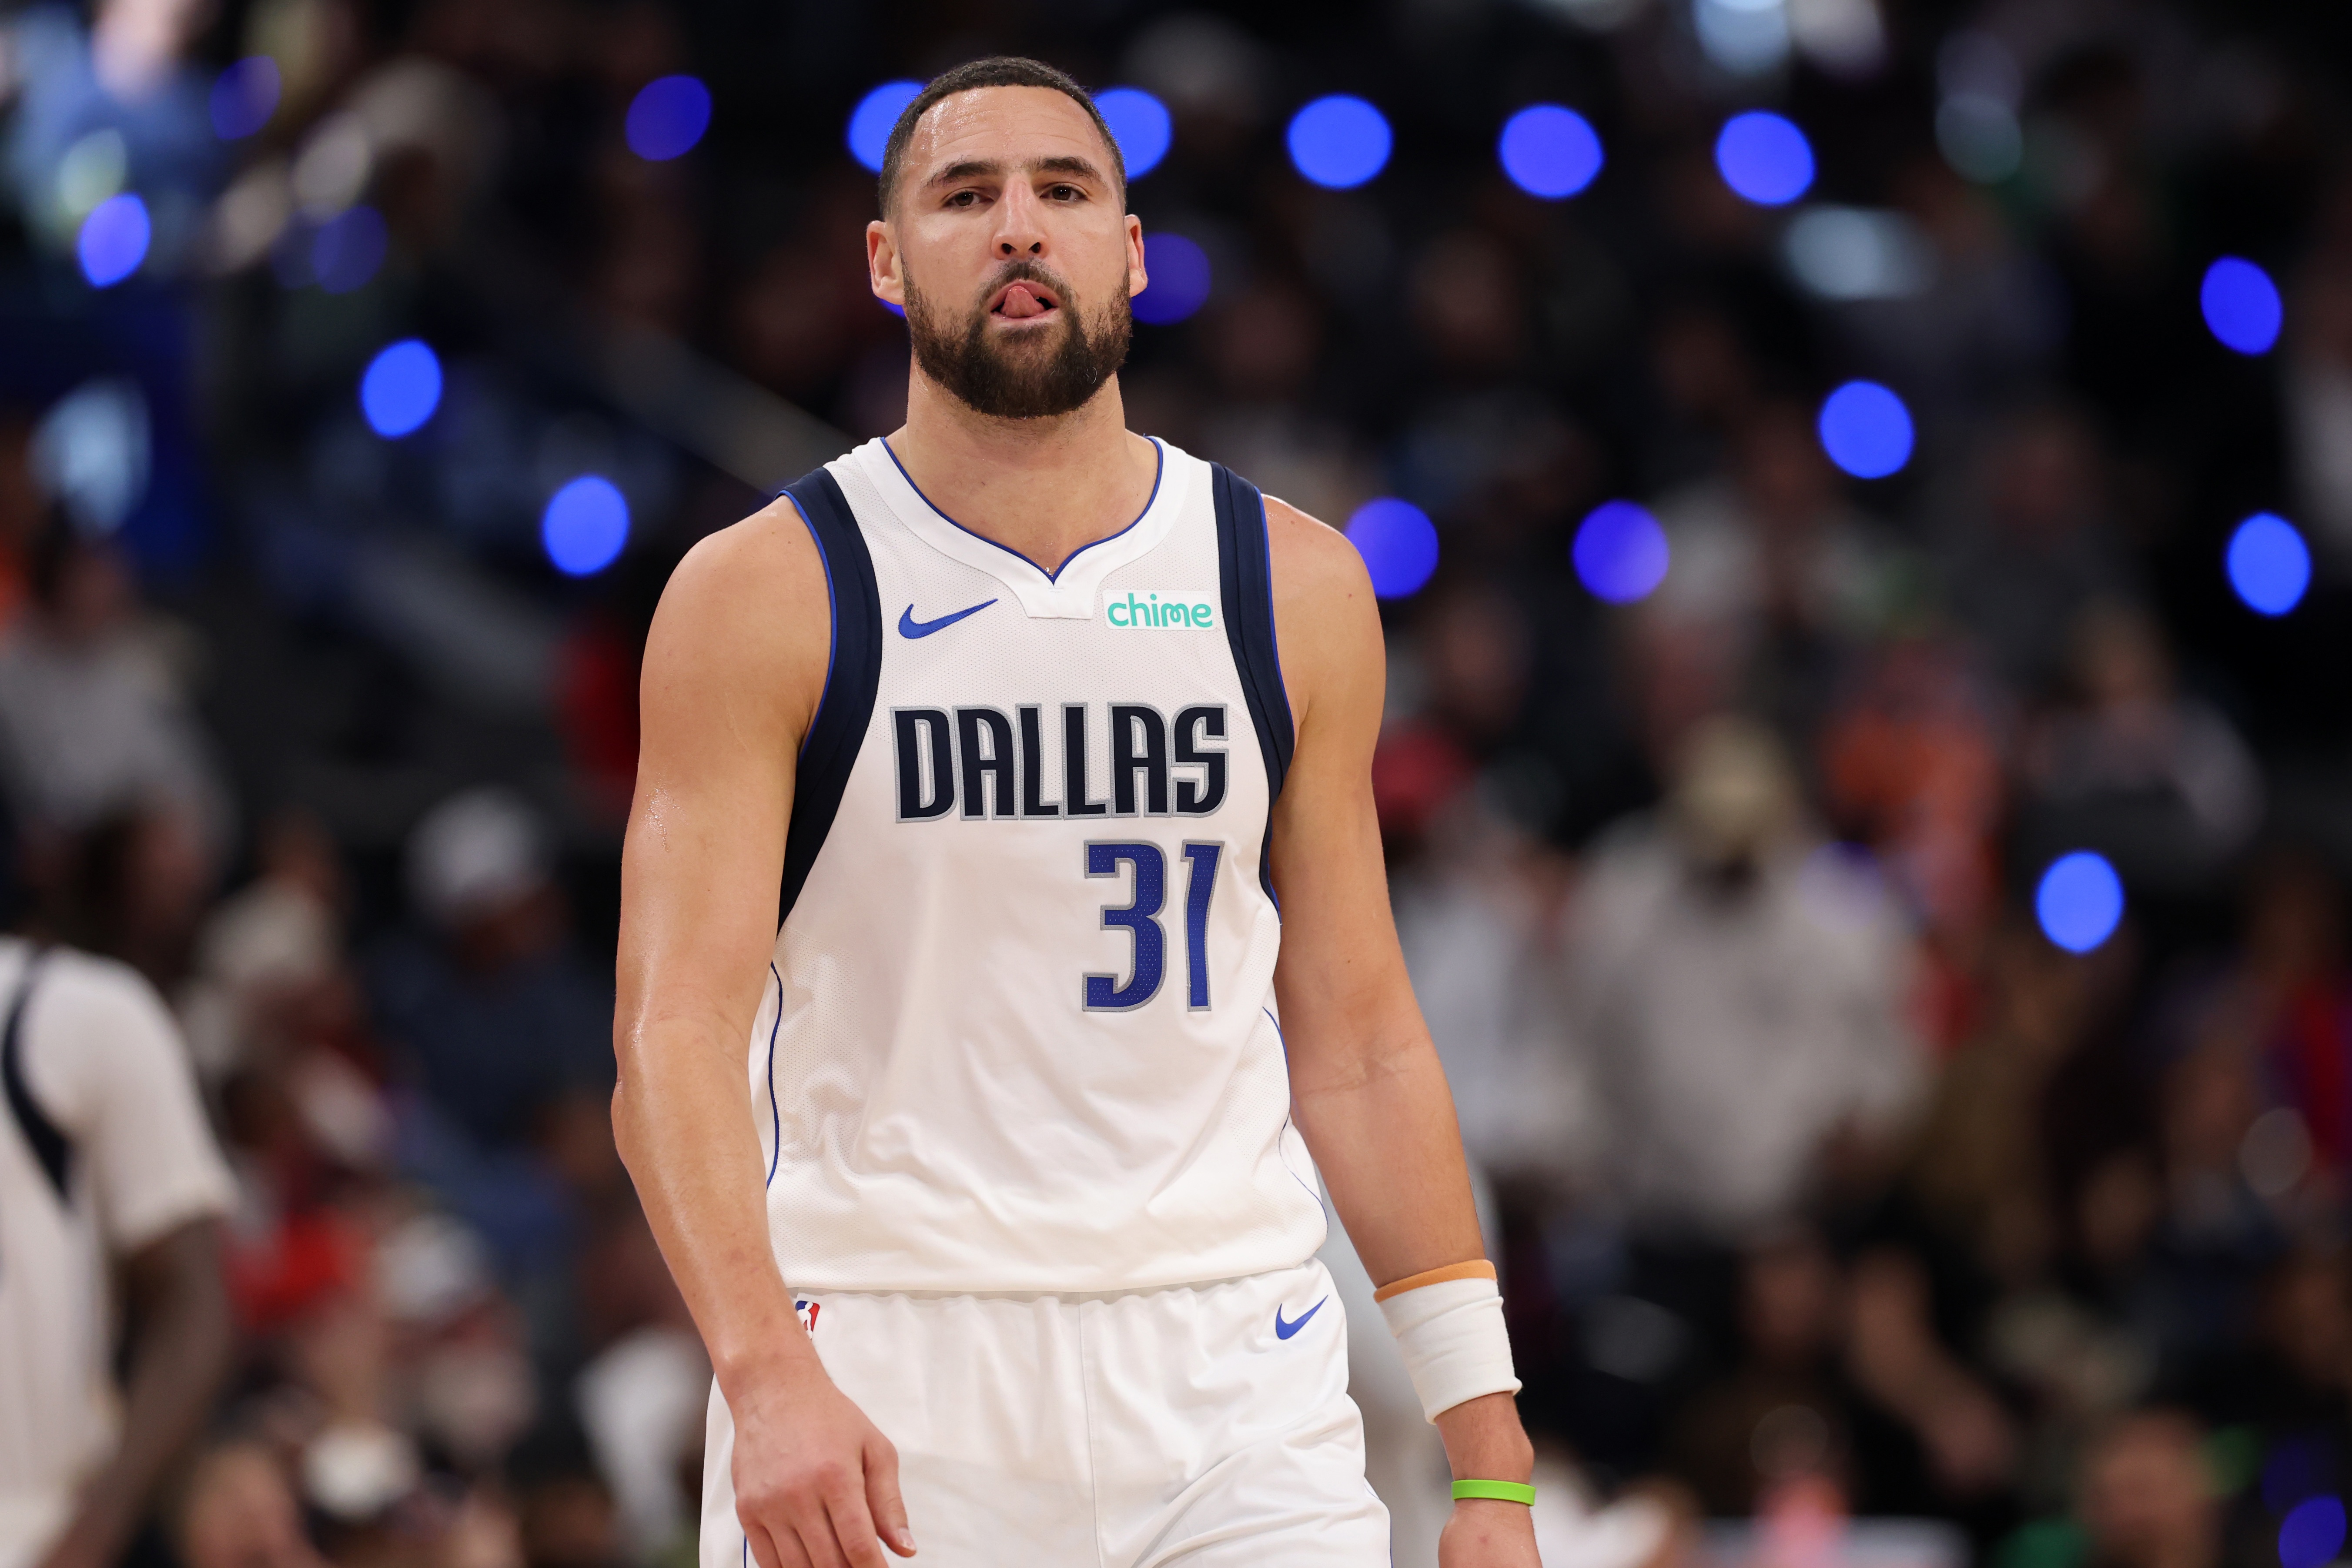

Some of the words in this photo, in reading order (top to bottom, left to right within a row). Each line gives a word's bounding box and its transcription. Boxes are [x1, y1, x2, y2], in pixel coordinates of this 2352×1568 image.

[1108, 593, 1213, 628] chime
[890, 702, 1228, 823] DALLAS
[1082, 839, 1225, 1012] 31
